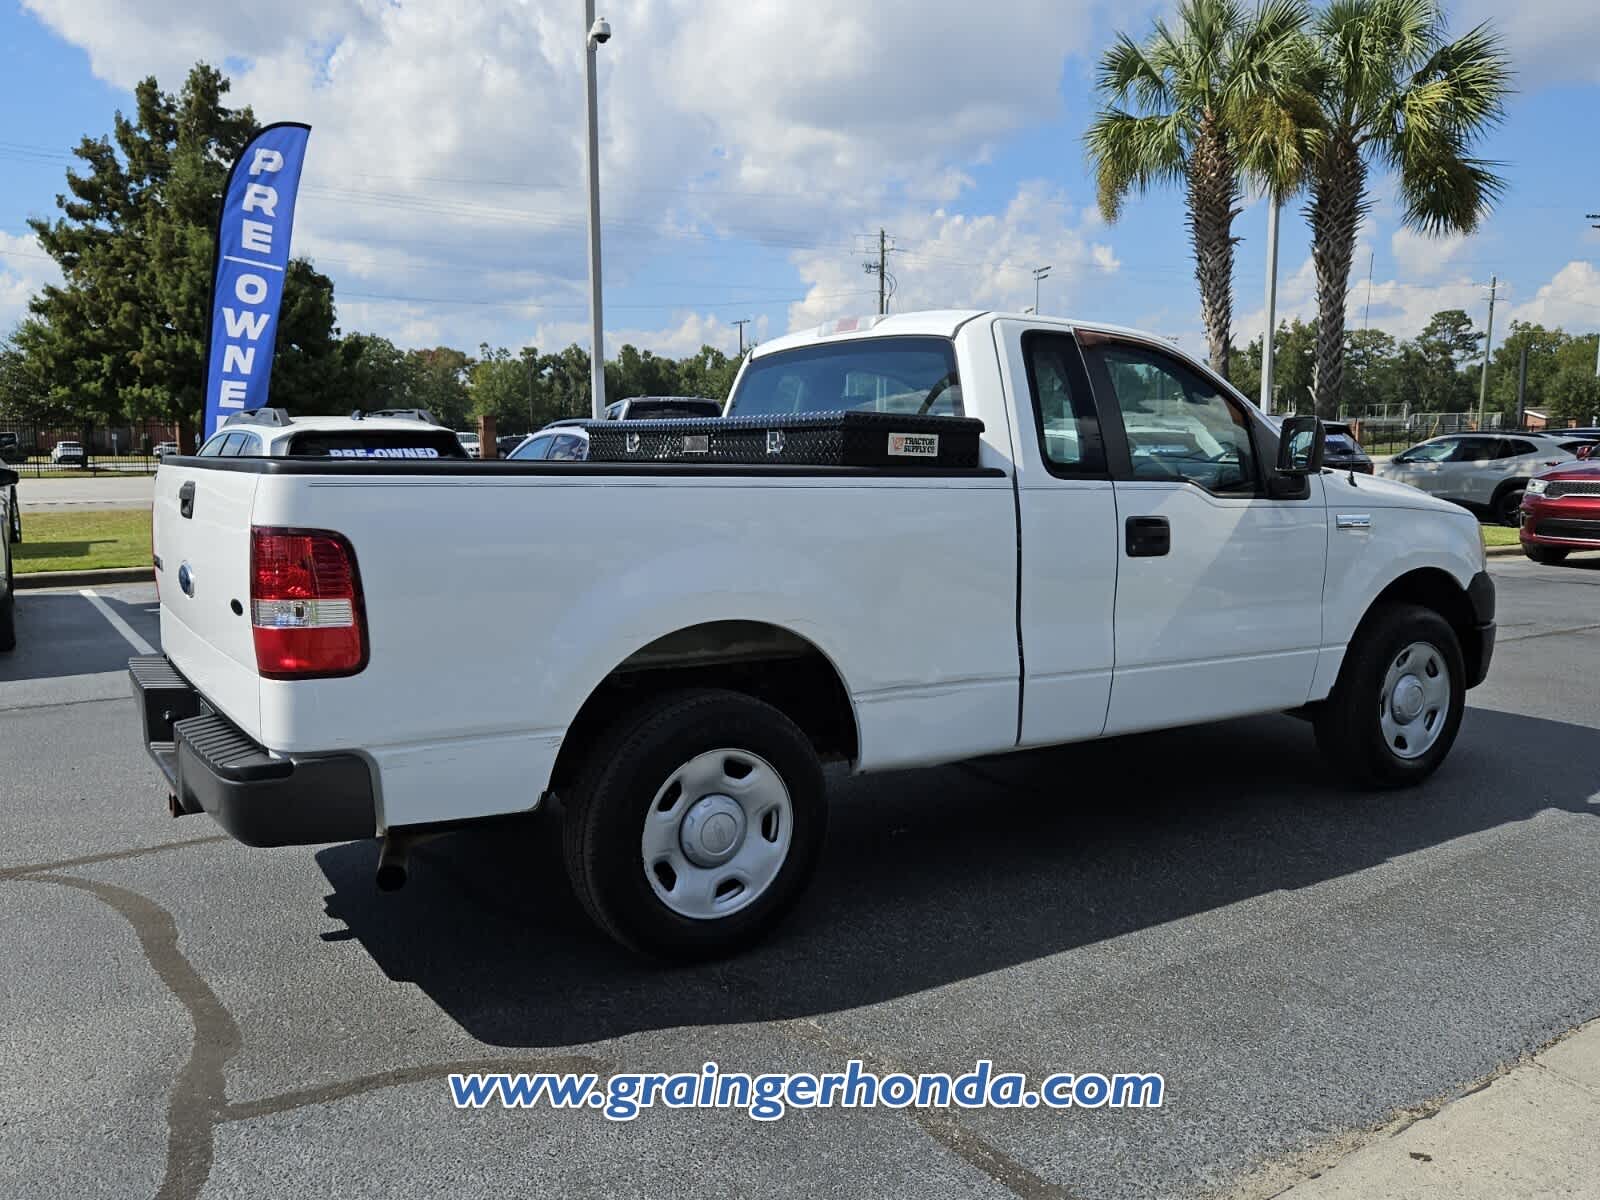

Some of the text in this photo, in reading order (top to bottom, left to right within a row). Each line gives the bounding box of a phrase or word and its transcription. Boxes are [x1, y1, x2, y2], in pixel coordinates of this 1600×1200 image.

[904, 437, 936, 445] TRACTOR
[329, 447, 439, 458] PRE-OWNED
[903, 445, 927, 453] SUPPLY
